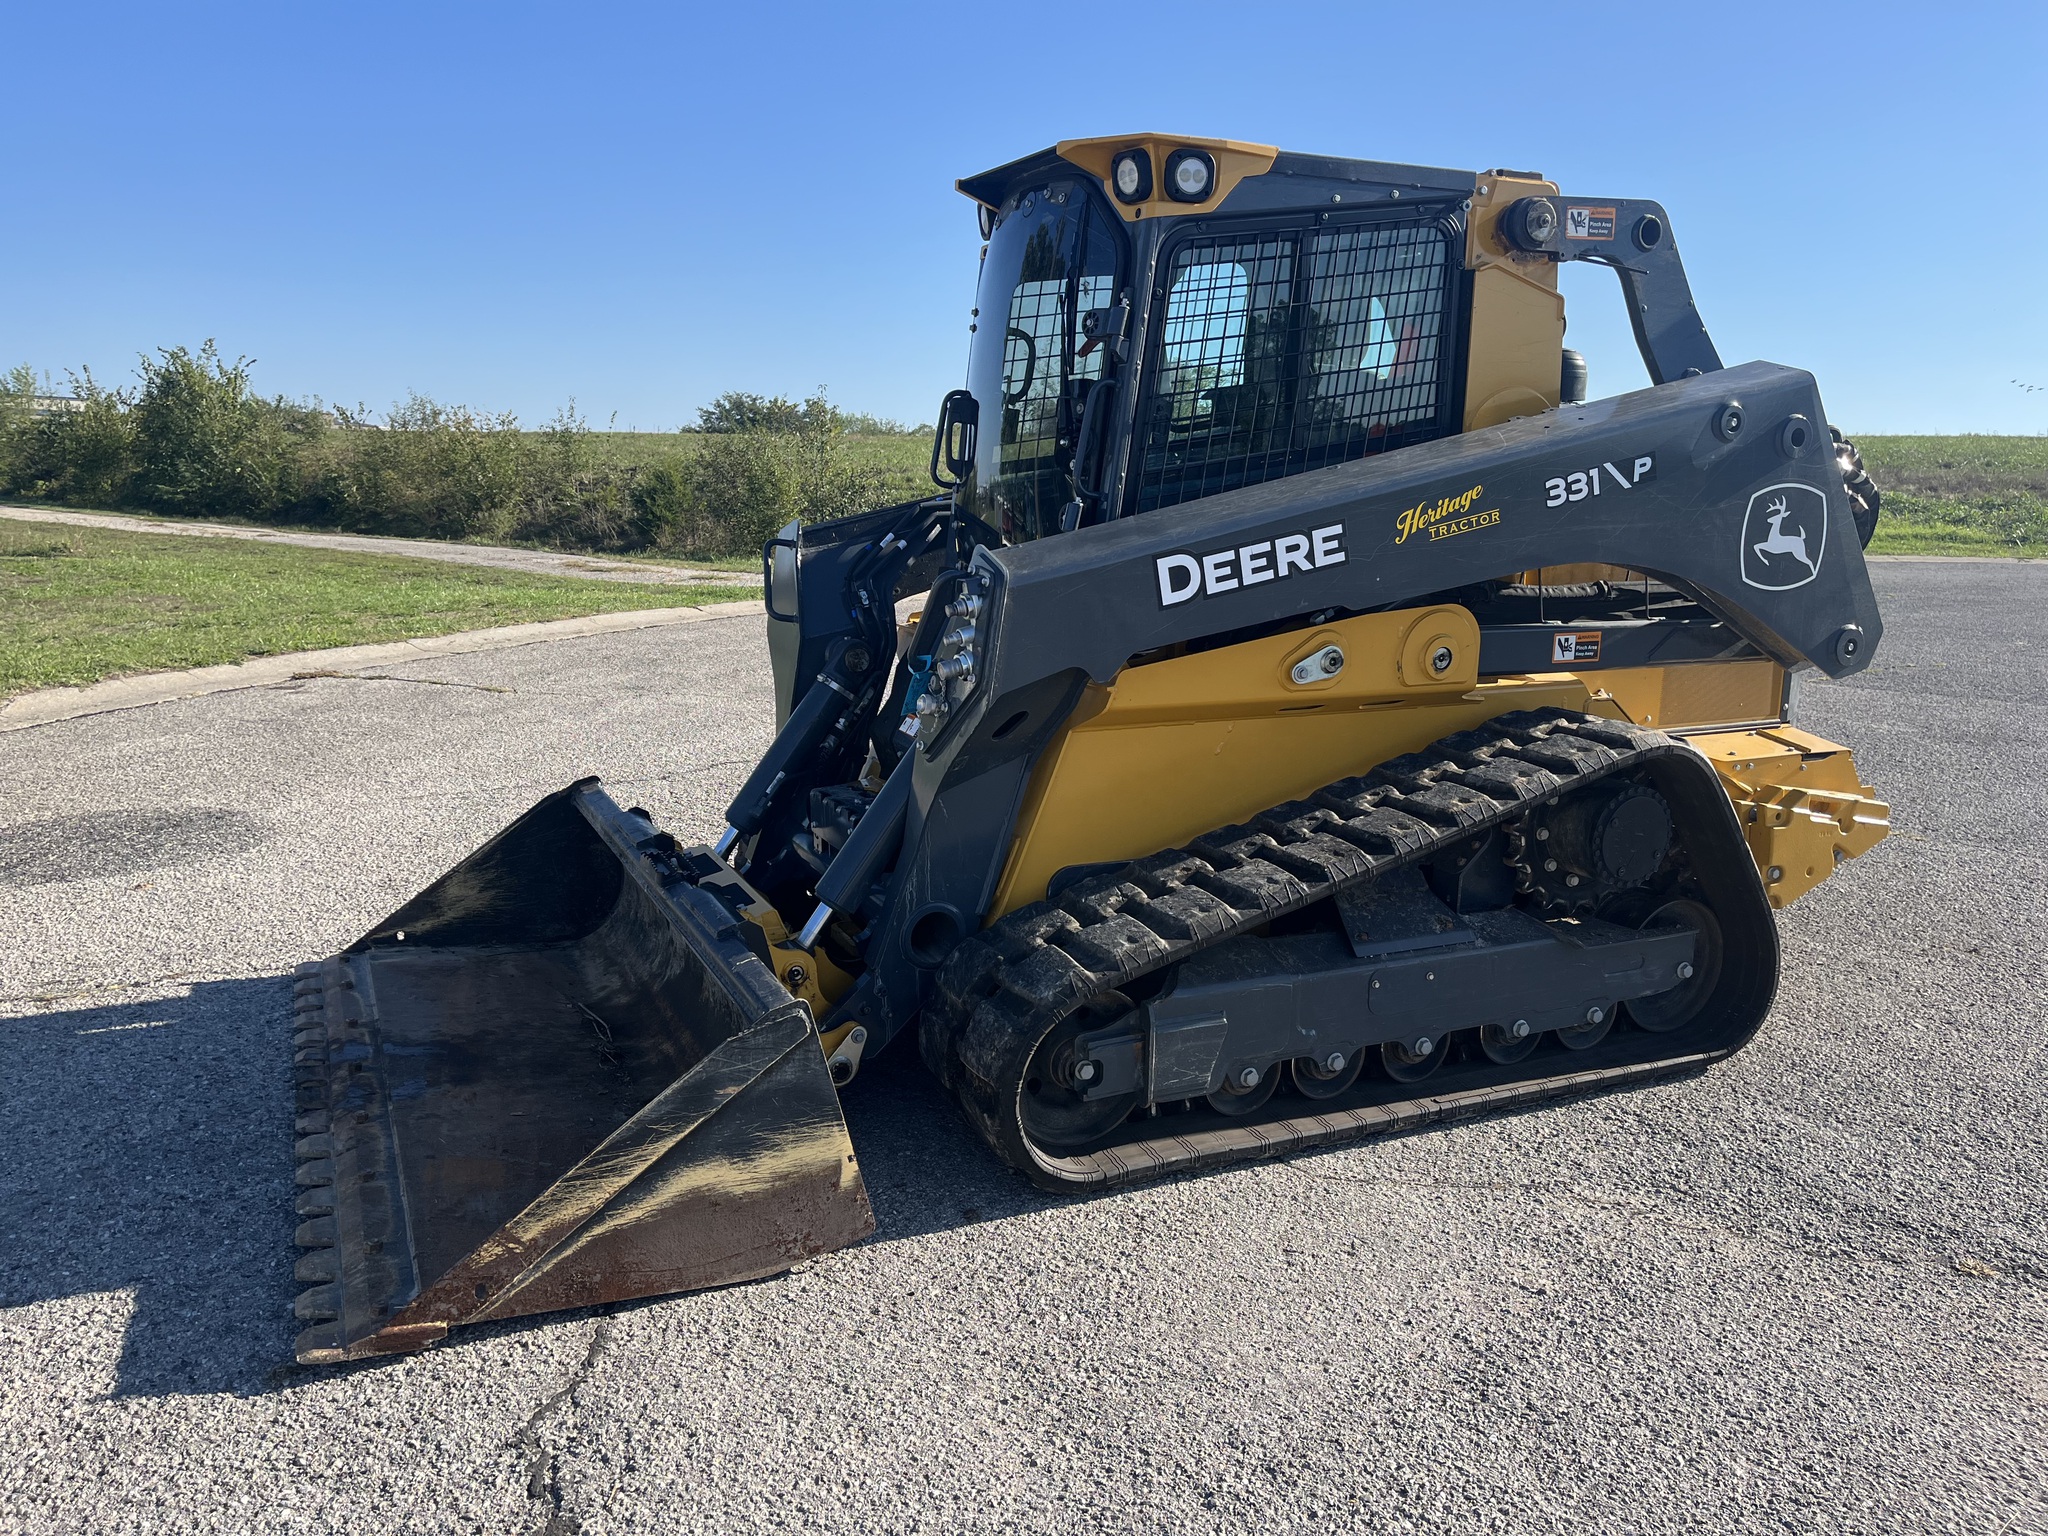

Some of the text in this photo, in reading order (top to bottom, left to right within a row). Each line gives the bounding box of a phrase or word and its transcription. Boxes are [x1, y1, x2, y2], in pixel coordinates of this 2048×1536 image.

[1395, 484, 1484, 545] Heritage
[1429, 511, 1501, 539] TRACTOR
[1156, 523, 1346, 606] DEERE
